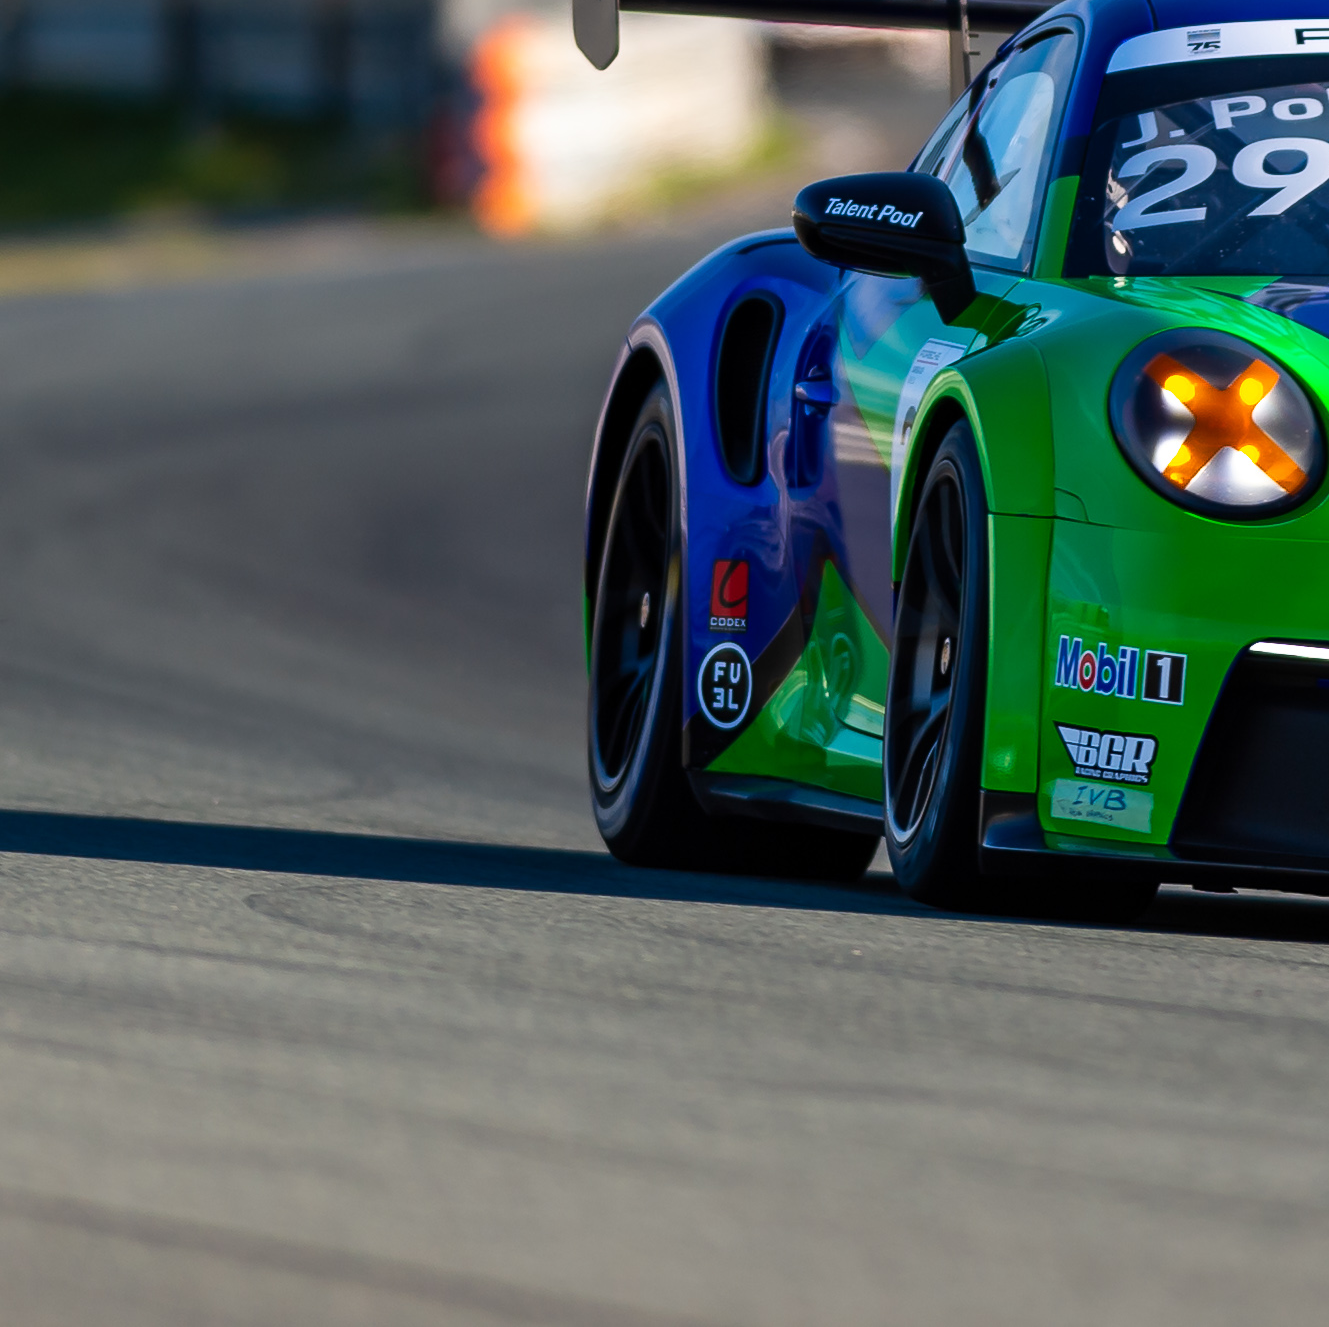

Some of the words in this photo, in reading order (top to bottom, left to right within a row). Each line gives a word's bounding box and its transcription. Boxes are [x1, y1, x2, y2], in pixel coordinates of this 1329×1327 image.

[1120, 111, 1186, 149] J.
[824, 197, 878, 219] Talent
[877, 204, 924, 228] Pool
[710, 616, 747, 627] CODEX
[1054, 634, 1140, 700] Mobil
